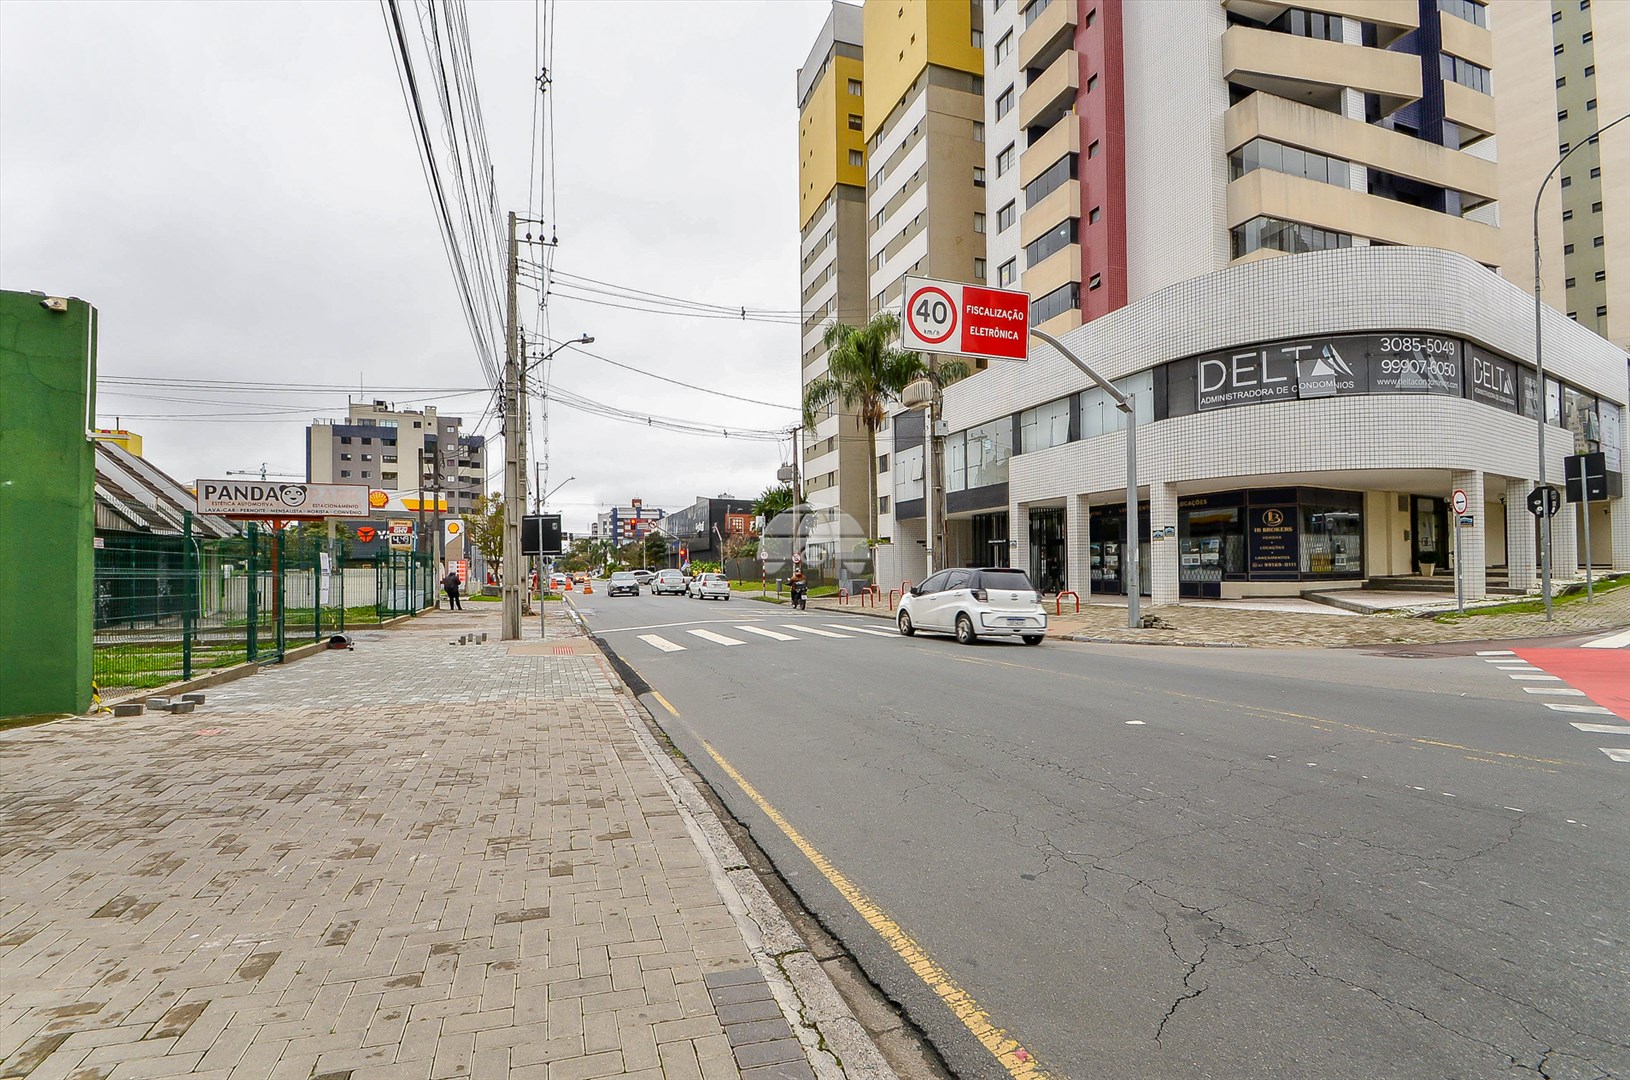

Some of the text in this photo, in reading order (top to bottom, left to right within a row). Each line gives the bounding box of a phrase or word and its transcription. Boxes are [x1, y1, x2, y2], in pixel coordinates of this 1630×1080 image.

[916, 299, 948, 325] 40
[966, 305, 1024, 321] FISCALIZAÇÃO
[923, 328, 940, 336] km/h
[970, 326, 1019, 340] ELETRÔNICA
[1380, 337, 1455, 356] 3085-5049
[1381, 359, 1456, 377] 99907-6050
[1200, 380, 1355, 405] ADMINISTRADORA DE CONDOMNIOS
[204, 484, 280, 501] PANDA
[1179, 498, 1208, 507] OCAÇÕES
